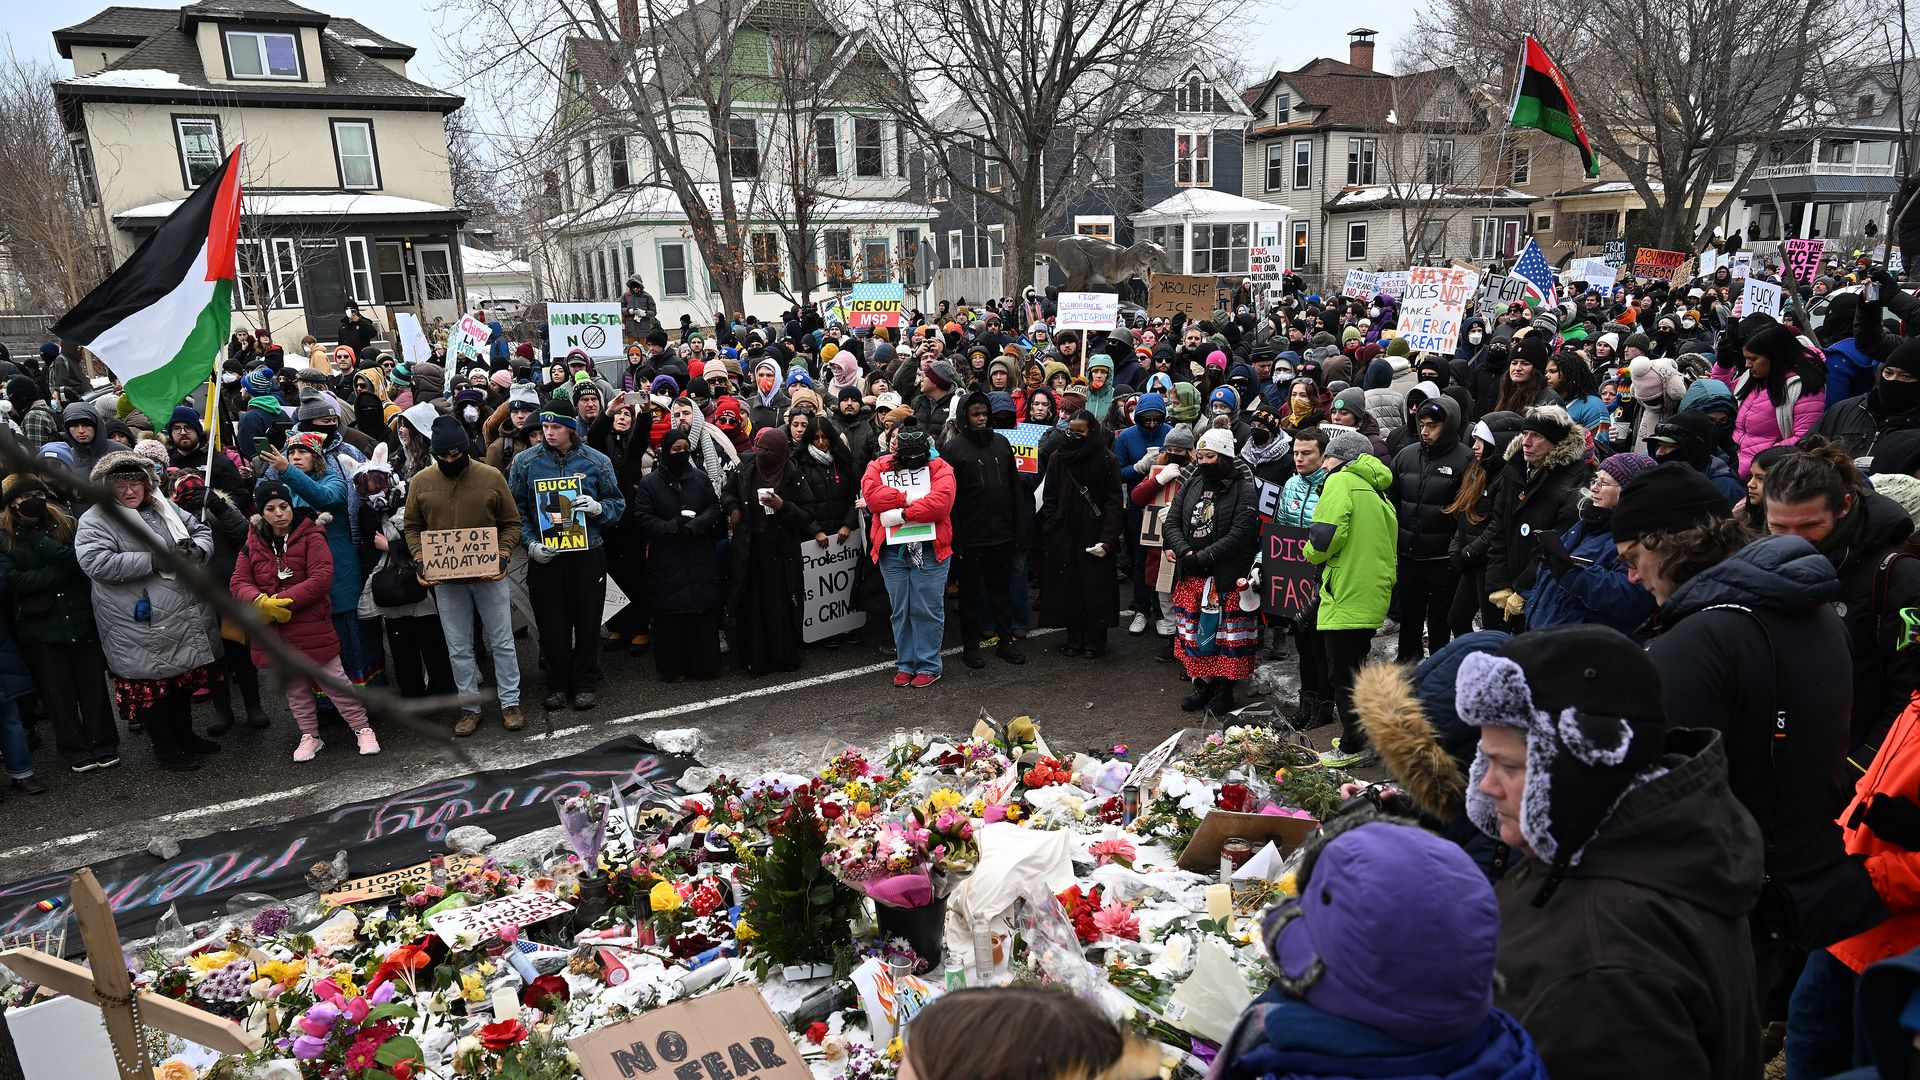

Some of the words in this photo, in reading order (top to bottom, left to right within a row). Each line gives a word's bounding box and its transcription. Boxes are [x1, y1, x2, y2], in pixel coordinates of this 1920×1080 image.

[1604, 241, 1626, 253] FROM
[1640, 249, 1657, 257] YOU
[1789, 240, 1806, 250] END
[1807, 242, 1824, 252] THE
[1263, 255, 1271, 264] US
[1272, 255, 1280, 263] TO
[1787, 249, 1820, 265] ICE
[1264, 264, 1277, 272] OUR
[1349, 271, 1364, 281] MN
[1363, 274, 1380, 285] NICE
[1410, 266, 1466, 285] HATE
[1160, 281, 1207, 298] ABOLISH
[1345, 287, 1357, 297] NO
[1352, 281, 1372, 291] MEANS
[1404, 284, 1440, 300] DOES
[1440, 284, 1468, 302] NOT
[1486, 275, 1529, 301] FIGHT
[1750, 285, 1775, 307] FUCK
[851, 300, 872, 312] ICE
[873, 300, 901, 312] OUT
[1166, 301, 1194, 313] ICE
[1400, 306, 1432, 316] MAKE
[551, 313, 621, 326] MINNESOTA
[860, 313, 889, 326] MSP
[1400, 316, 1457, 337] AMERICA
[463, 334, 475, 347] LA
[537, 478, 578, 492] BUCK
[886, 472, 921, 487] FREE
[426, 530, 462, 545] IT'S
[544, 534, 585, 550] MAN
[433, 543, 455, 557] I'M
[462, 542, 491, 553] NOT
[803, 588, 814, 602] is
[804, 617, 813, 627] a
[818, 599, 858, 623] CRIM
[609, 1030, 689, 1078] NO
[673, 1036, 788, 1080] FEAR
